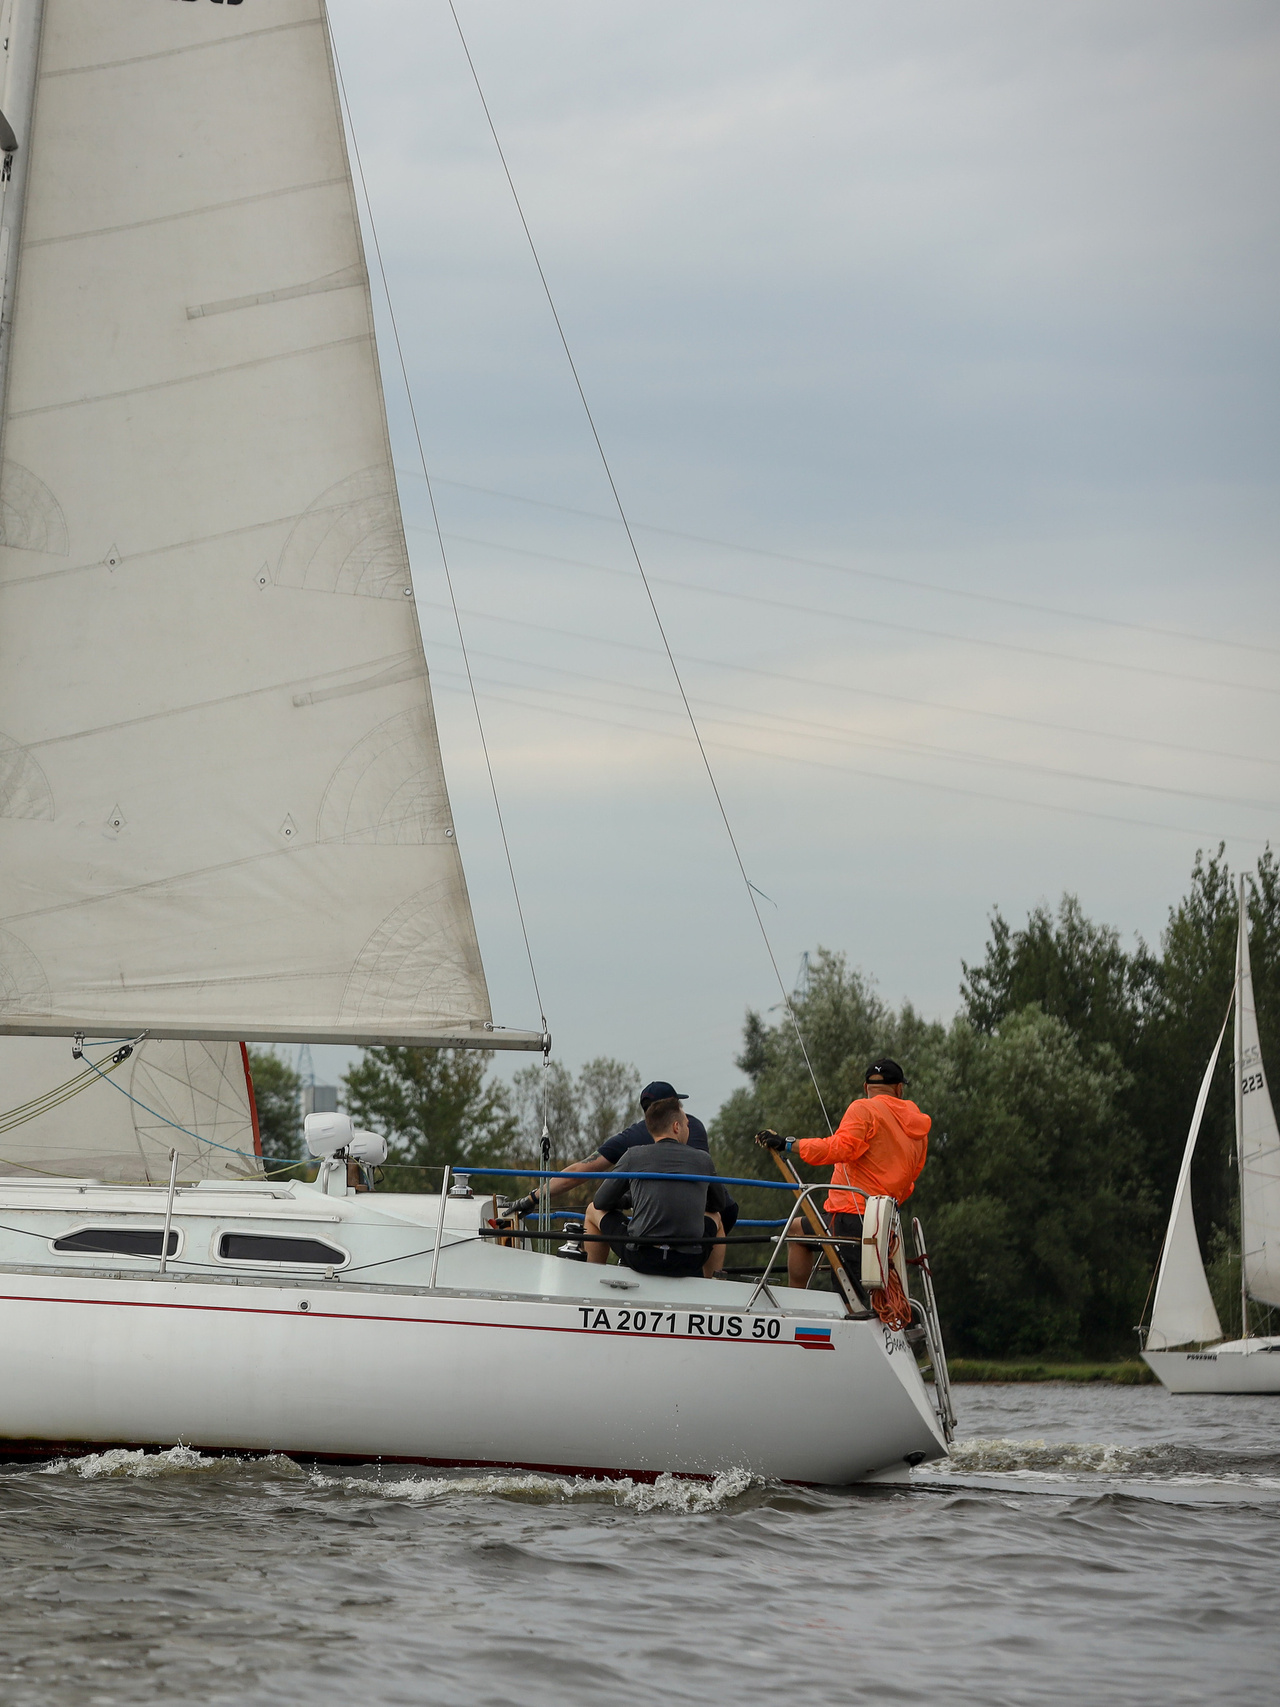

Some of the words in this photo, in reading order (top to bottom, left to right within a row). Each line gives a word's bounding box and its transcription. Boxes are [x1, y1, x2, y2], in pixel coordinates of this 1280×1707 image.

[1242, 1072, 1264, 1094] 223
[619, 1310, 677, 1333] 2071
[687, 1314, 743, 1337] RUS
[752, 1318, 781, 1339] 50
